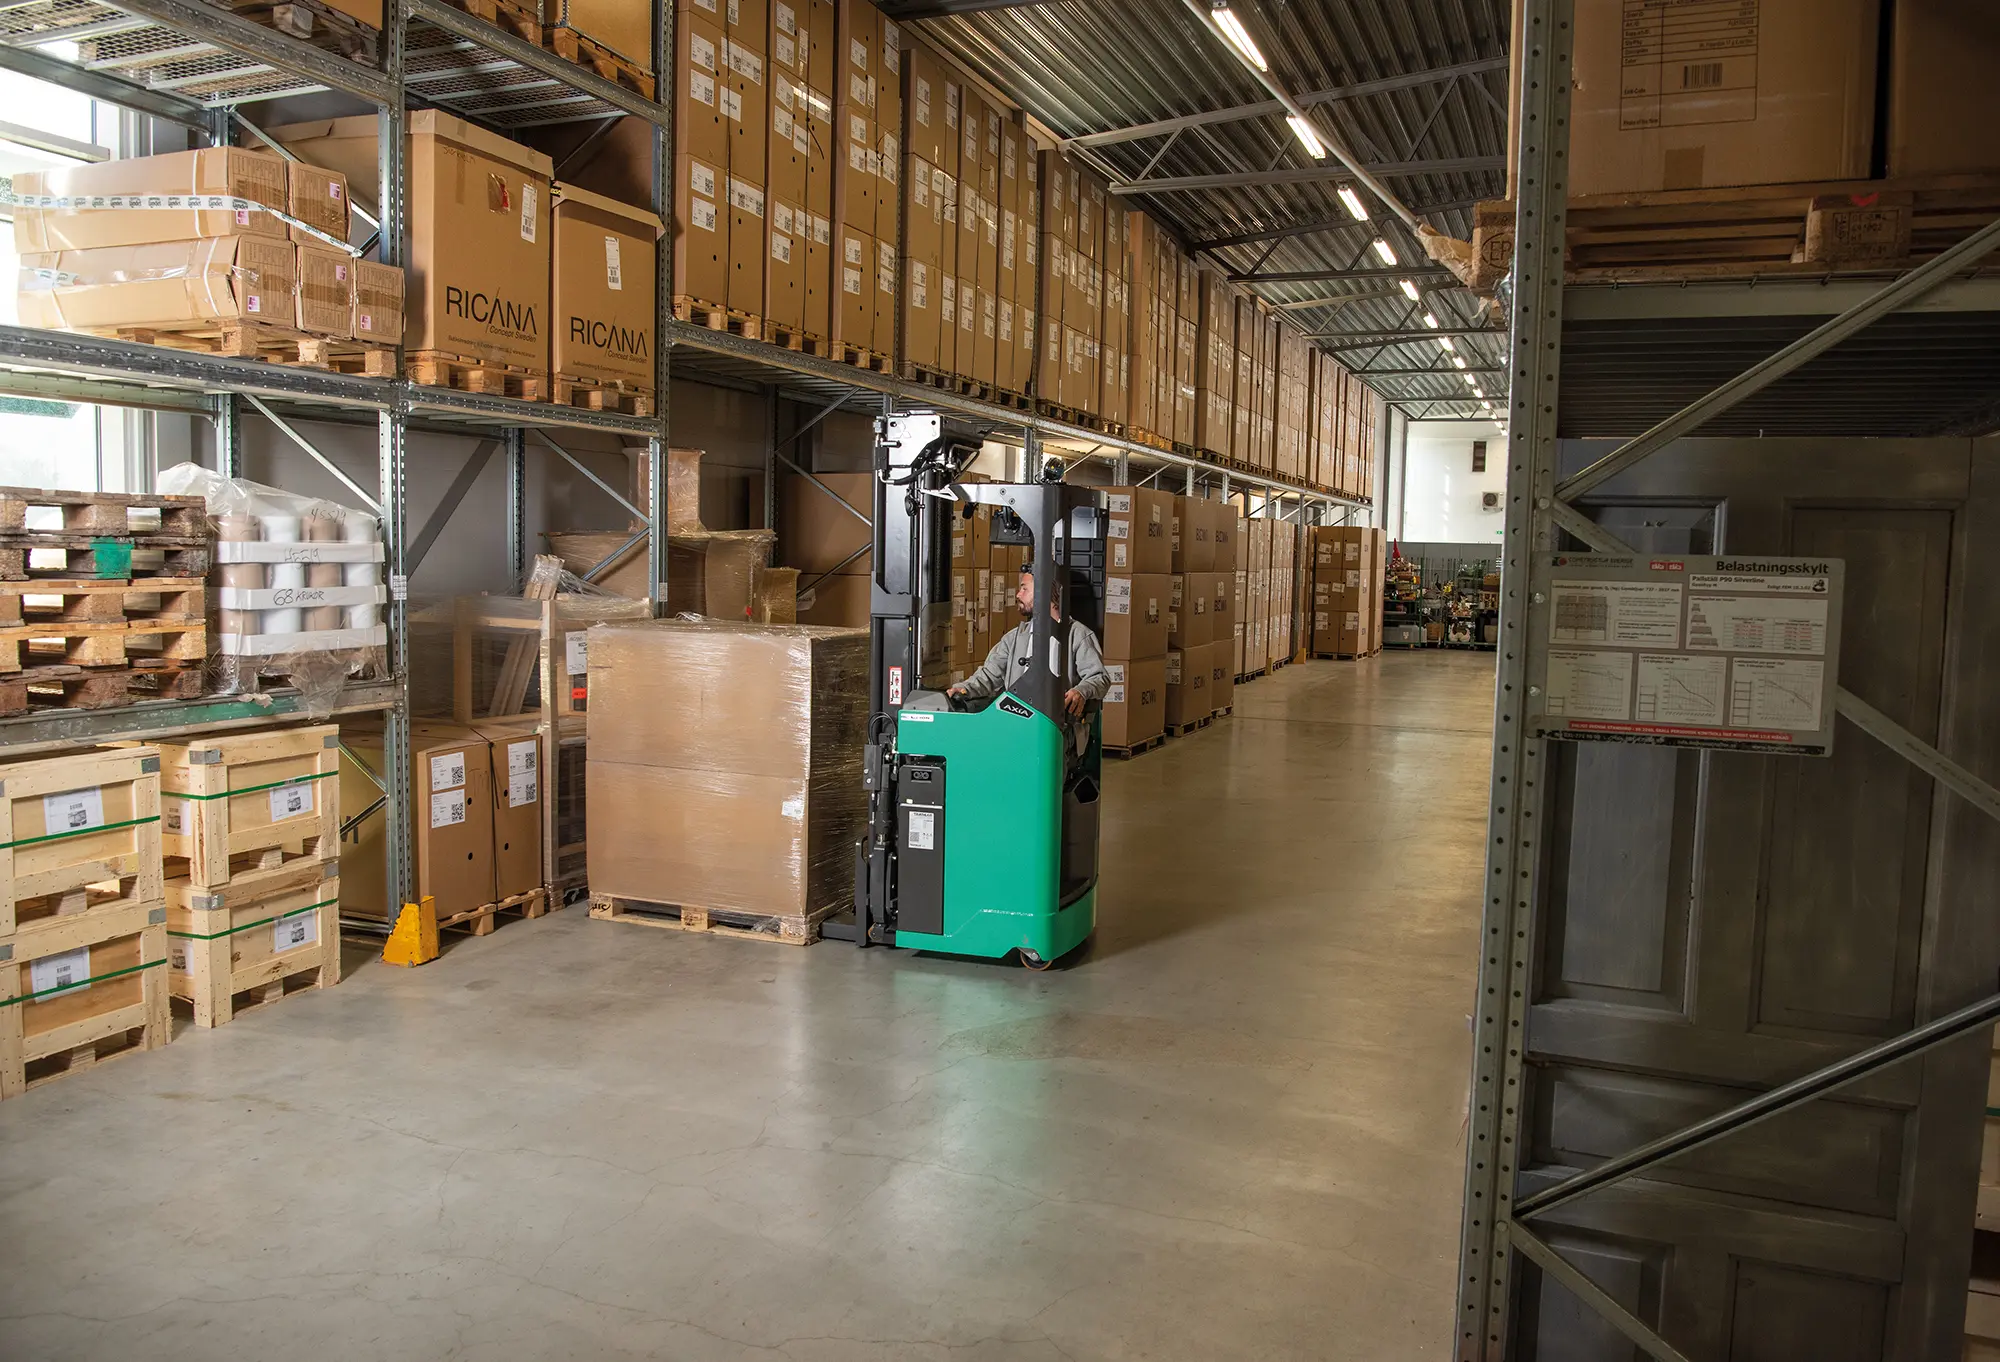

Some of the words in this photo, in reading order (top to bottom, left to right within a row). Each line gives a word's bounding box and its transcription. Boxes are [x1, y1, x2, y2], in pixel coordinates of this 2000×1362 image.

[490, 325, 514, 339] Concept
[514, 332, 536, 342] Sweden
[1716, 560, 1829, 575] Belastningsskylt
[274, 588, 293, 606] 68
[296, 590, 324, 602] KRUKOR
[1003, 704, 1029, 716] AXIA
